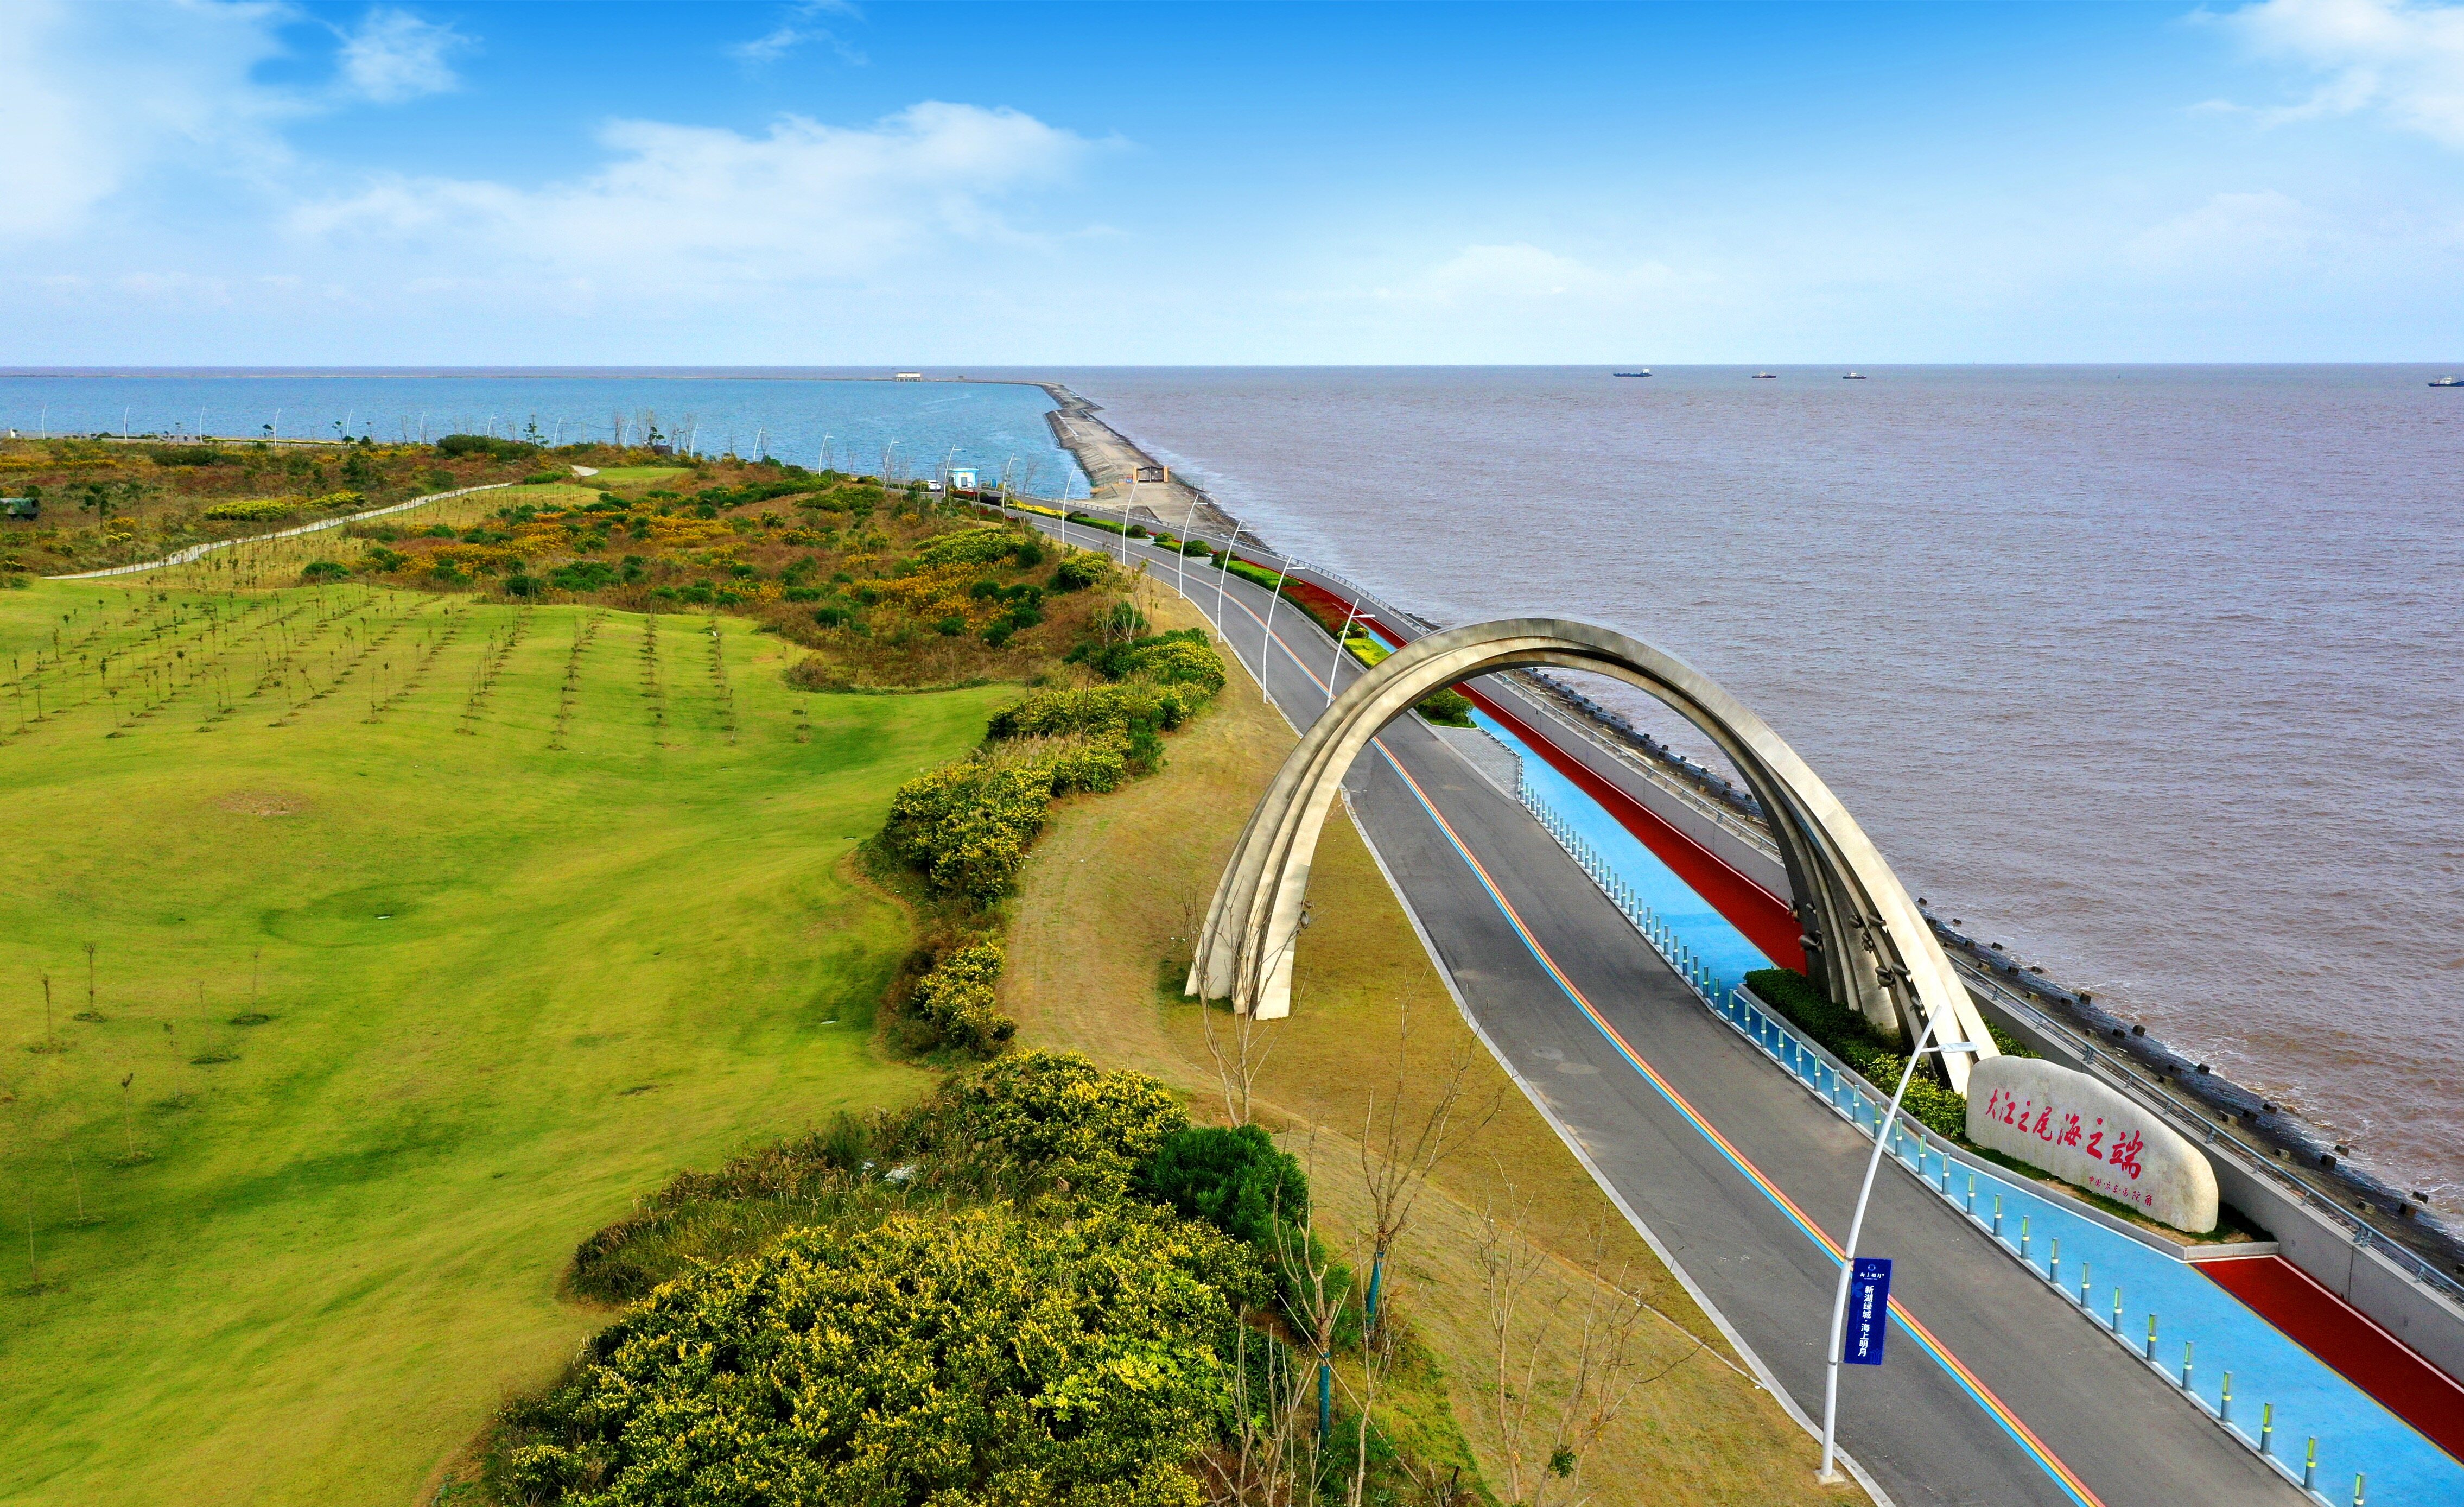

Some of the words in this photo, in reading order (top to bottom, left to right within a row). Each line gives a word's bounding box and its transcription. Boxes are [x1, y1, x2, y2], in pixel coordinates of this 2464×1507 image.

[1985, 1088, 2144, 1180] 大江之尾海之端
